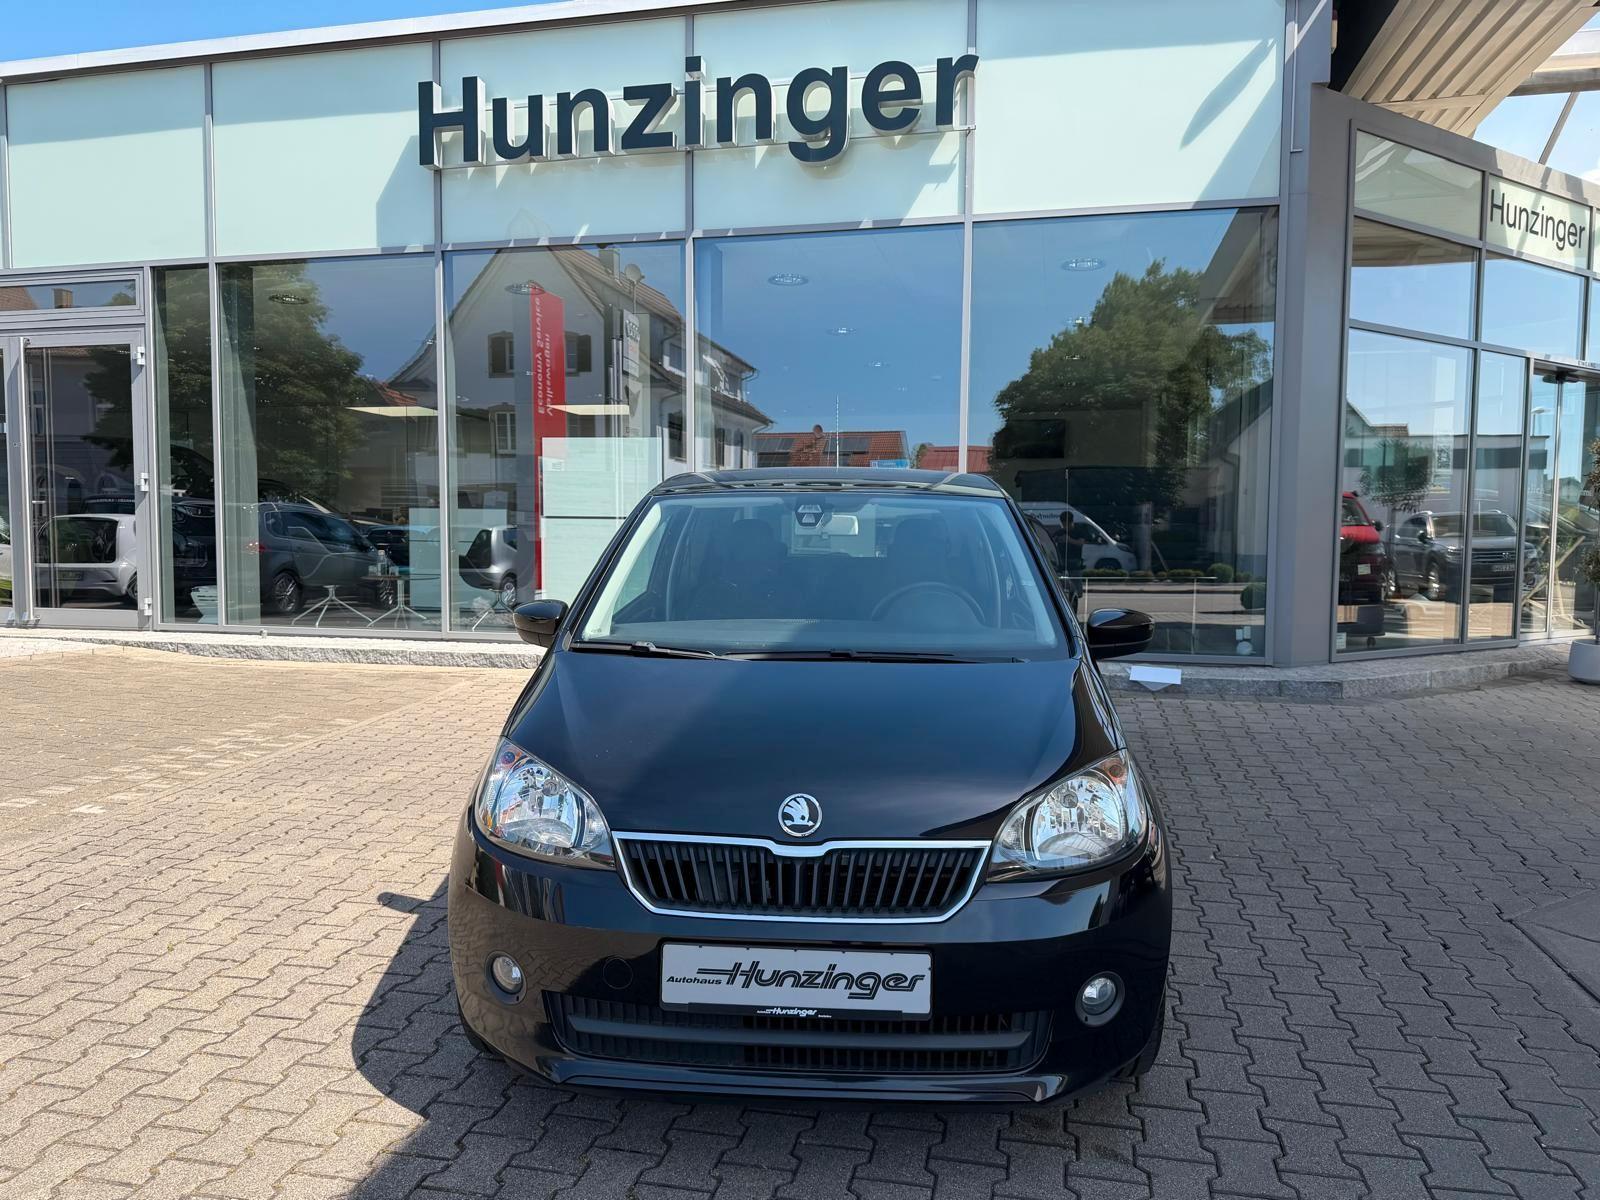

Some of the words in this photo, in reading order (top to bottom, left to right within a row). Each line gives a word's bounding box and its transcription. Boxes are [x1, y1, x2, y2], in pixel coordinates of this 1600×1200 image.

[418, 55, 979, 168] Hunzinger
[1489, 188, 1586, 251] Hunzinger
[666, 975, 723, 986] Autohaus
[697, 960, 926, 1000] Hunzinger
[766, 1007, 818, 1017] Hunzinger
